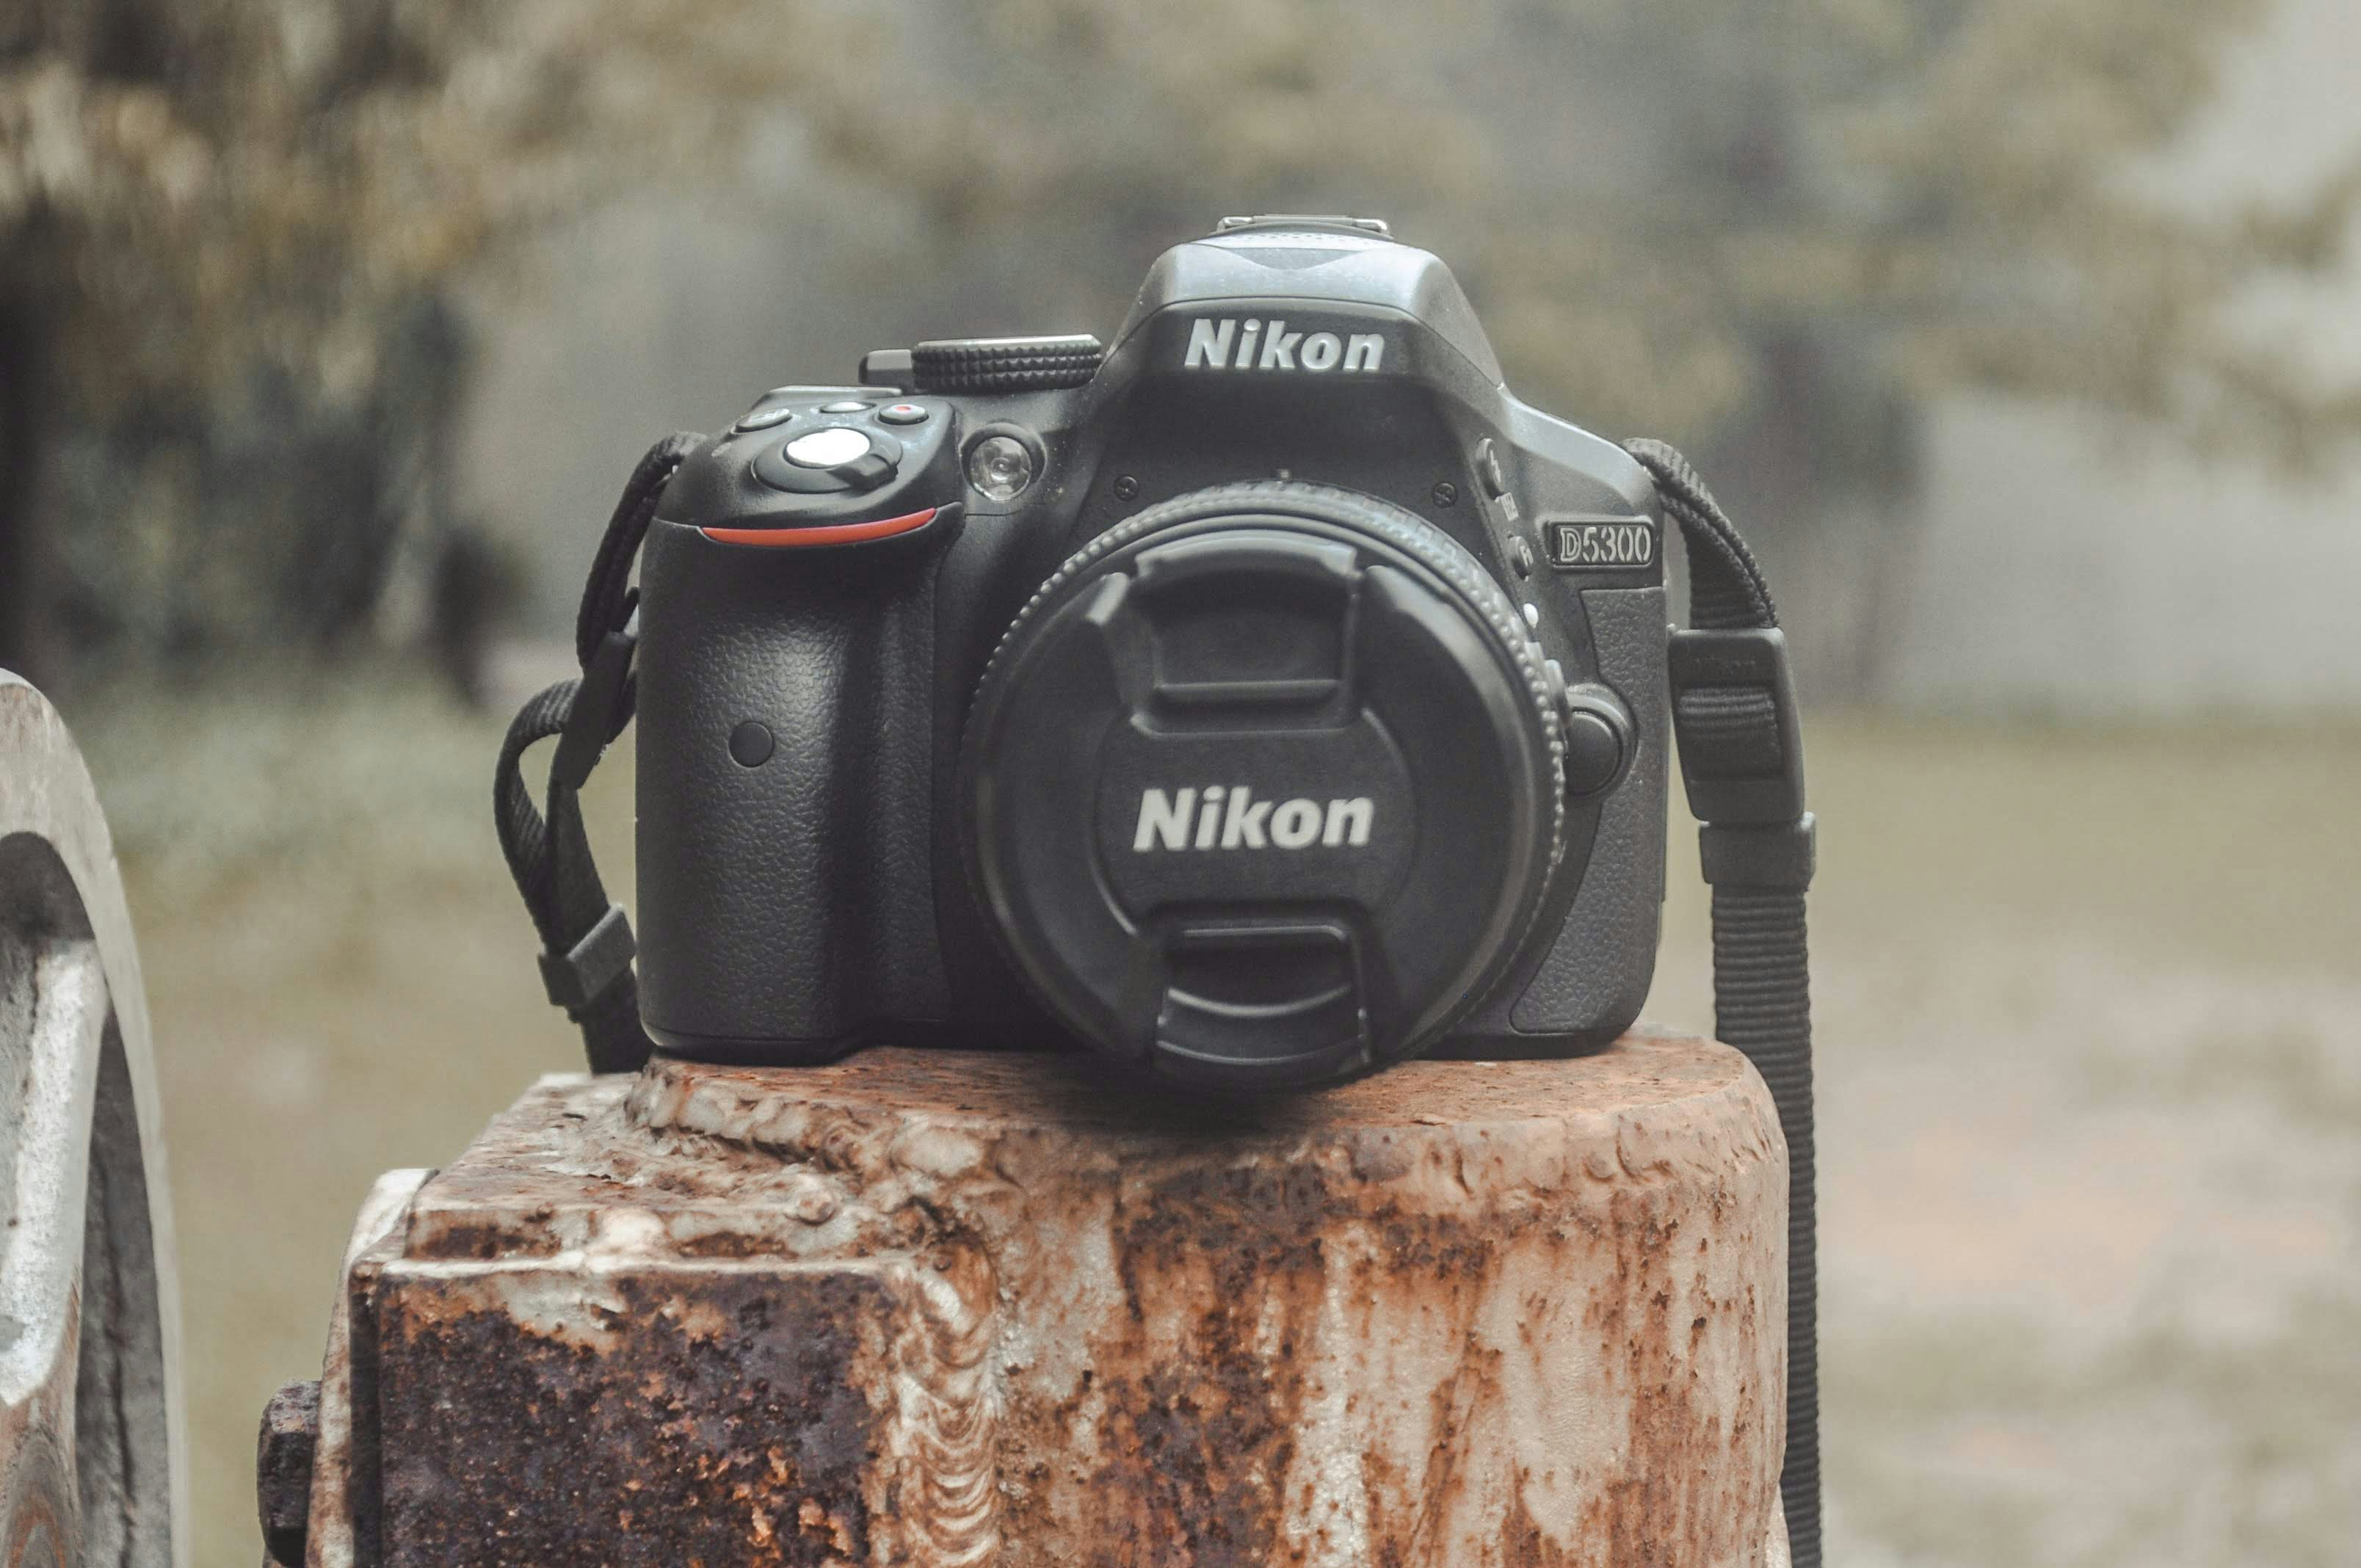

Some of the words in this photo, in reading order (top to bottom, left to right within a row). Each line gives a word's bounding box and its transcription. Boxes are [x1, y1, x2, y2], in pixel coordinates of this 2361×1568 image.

[1184, 318, 1385, 371] Nikon
[1560, 526, 1652, 562] D5300
[1133, 785, 1375, 852] Nikon
